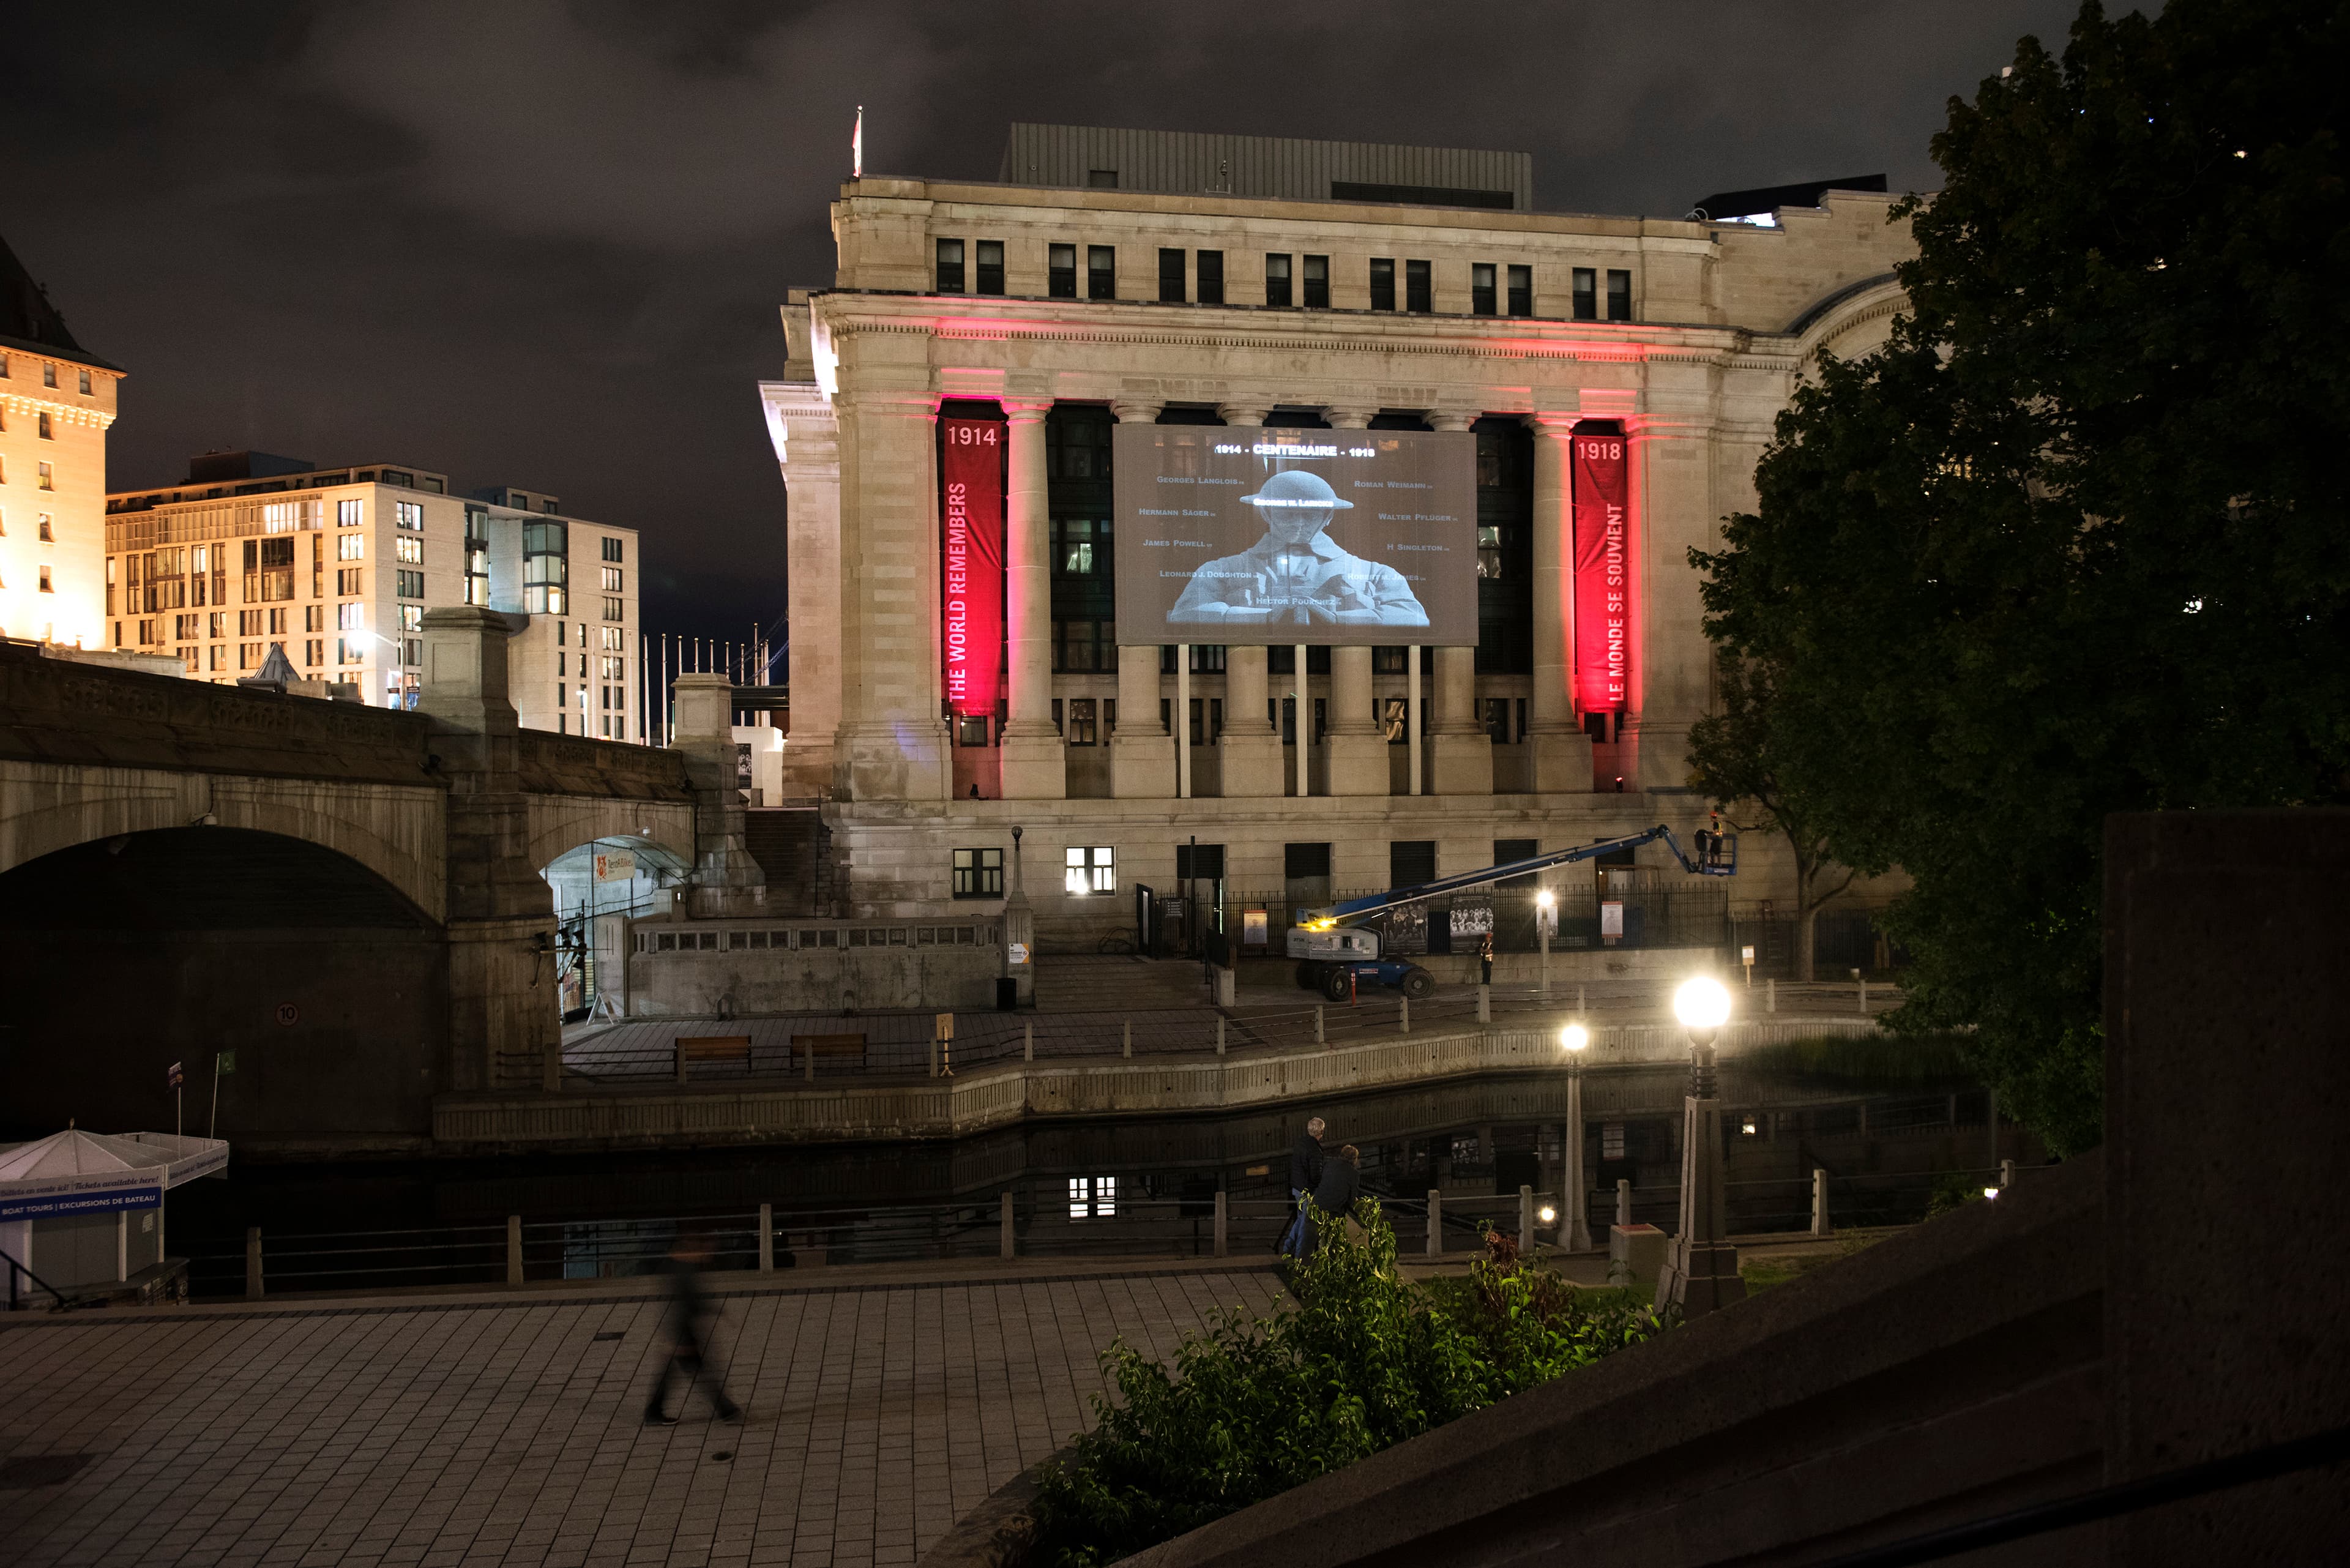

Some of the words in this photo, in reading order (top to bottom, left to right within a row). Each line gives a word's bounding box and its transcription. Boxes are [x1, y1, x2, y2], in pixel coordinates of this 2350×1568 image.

[949, 427, 996, 446] 1914
[1215, 445, 1241, 454] 1914
[1253, 444, 1337, 456] CENTENAIRE
[1349, 448, 1375, 457] 1918
[1578, 442, 1621, 460] 1918
[949, 482, 966, 594] REMEMBERS
[1606, 503, 1623, 586] SOUVIENT
[1608, 592, 1623, 612] SE
[949, 600, 966, 662] WORLD
[1608, 618, 1624, 676] MONDE
[949, 669, 965, 702] THE
[1609, 683, 1624, 701] LE
[280, 1007, 295, 1019] 10
[102, 1178, 138, 1187] available
[139, 1176, 159, 1184] here!
[26, 1204, 54, 1212] TOURS
[59, 1198, 110, 1209] EXCURSIONS
[125, 1195, 155, 1203] BATEAU
